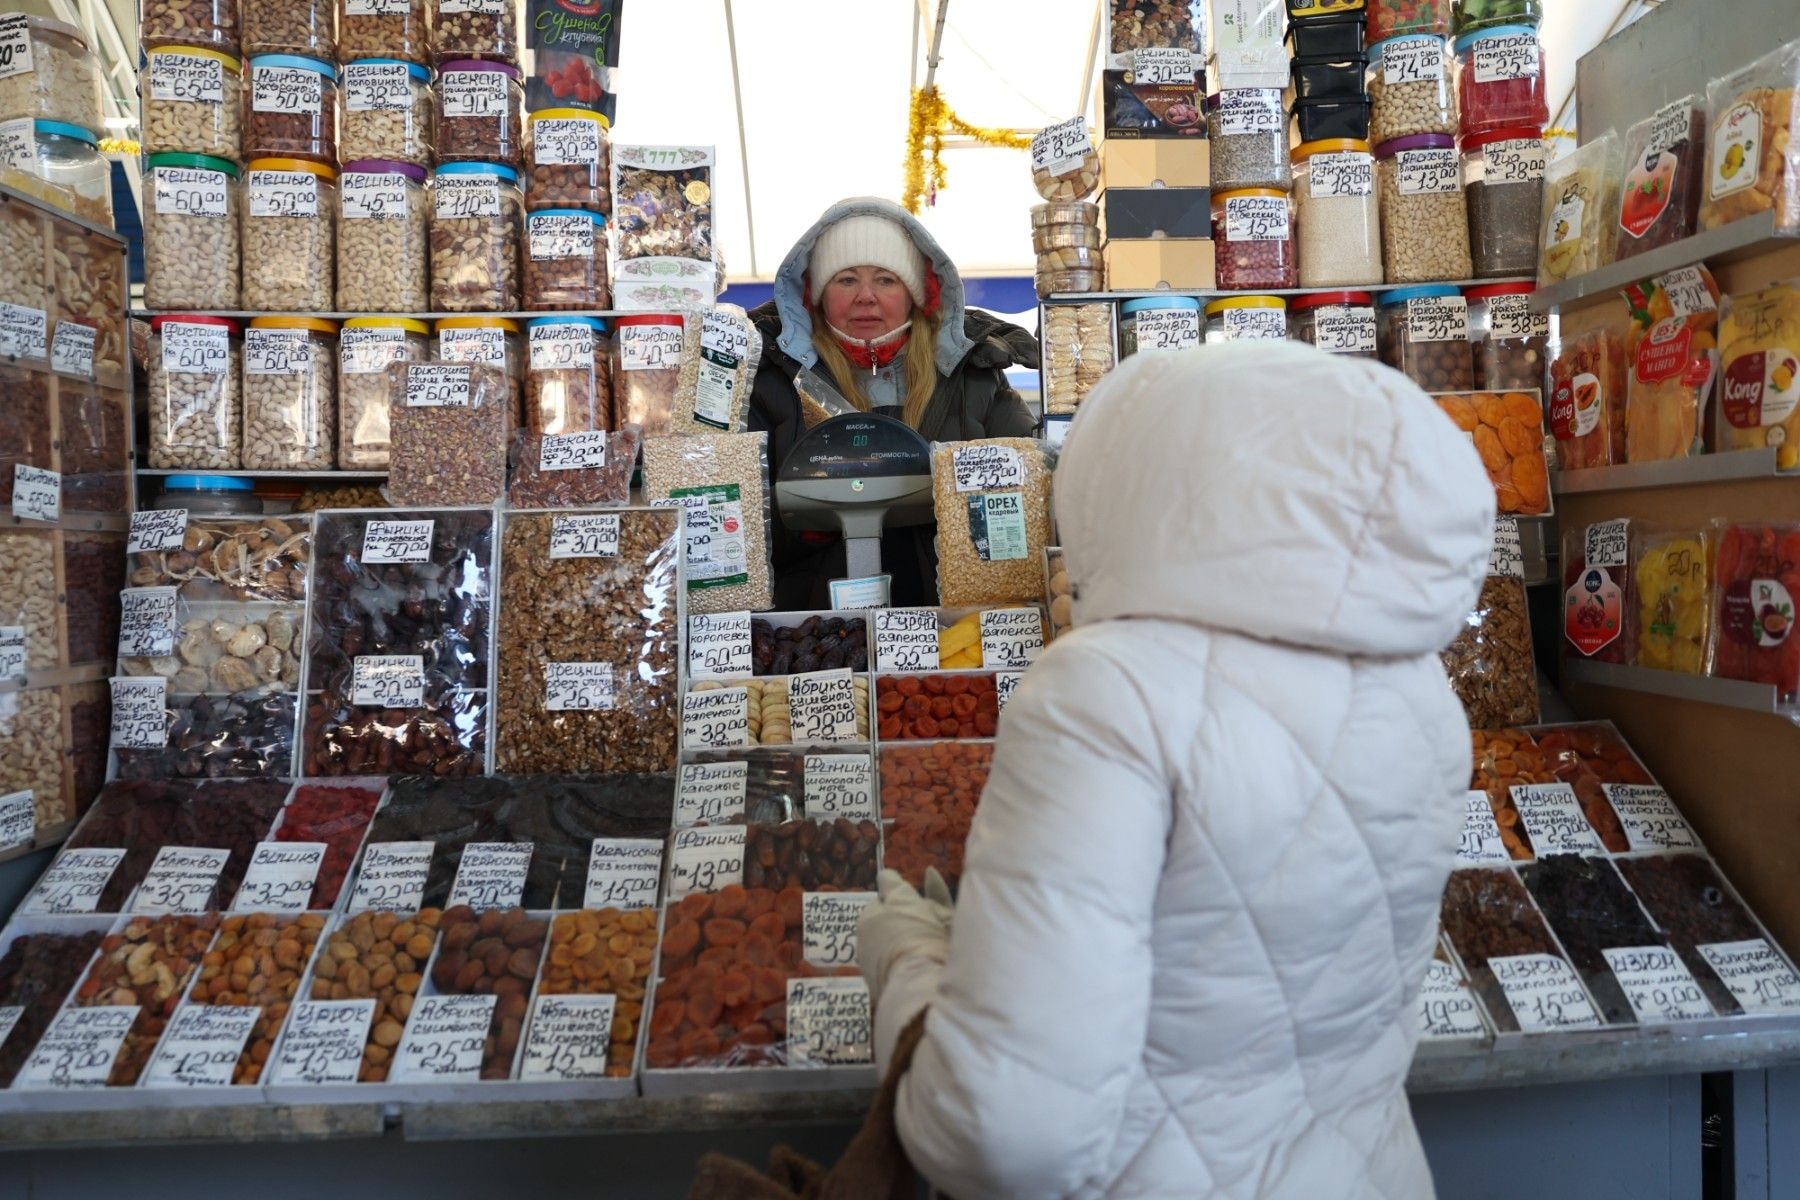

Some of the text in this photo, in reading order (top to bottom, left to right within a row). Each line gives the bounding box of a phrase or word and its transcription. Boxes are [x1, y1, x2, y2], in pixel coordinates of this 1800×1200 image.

[649, 150, 677, 164] 777
[1724, 377, 1761, 404] Kong
[987, 497, 1017, 509] ОРЕХ
